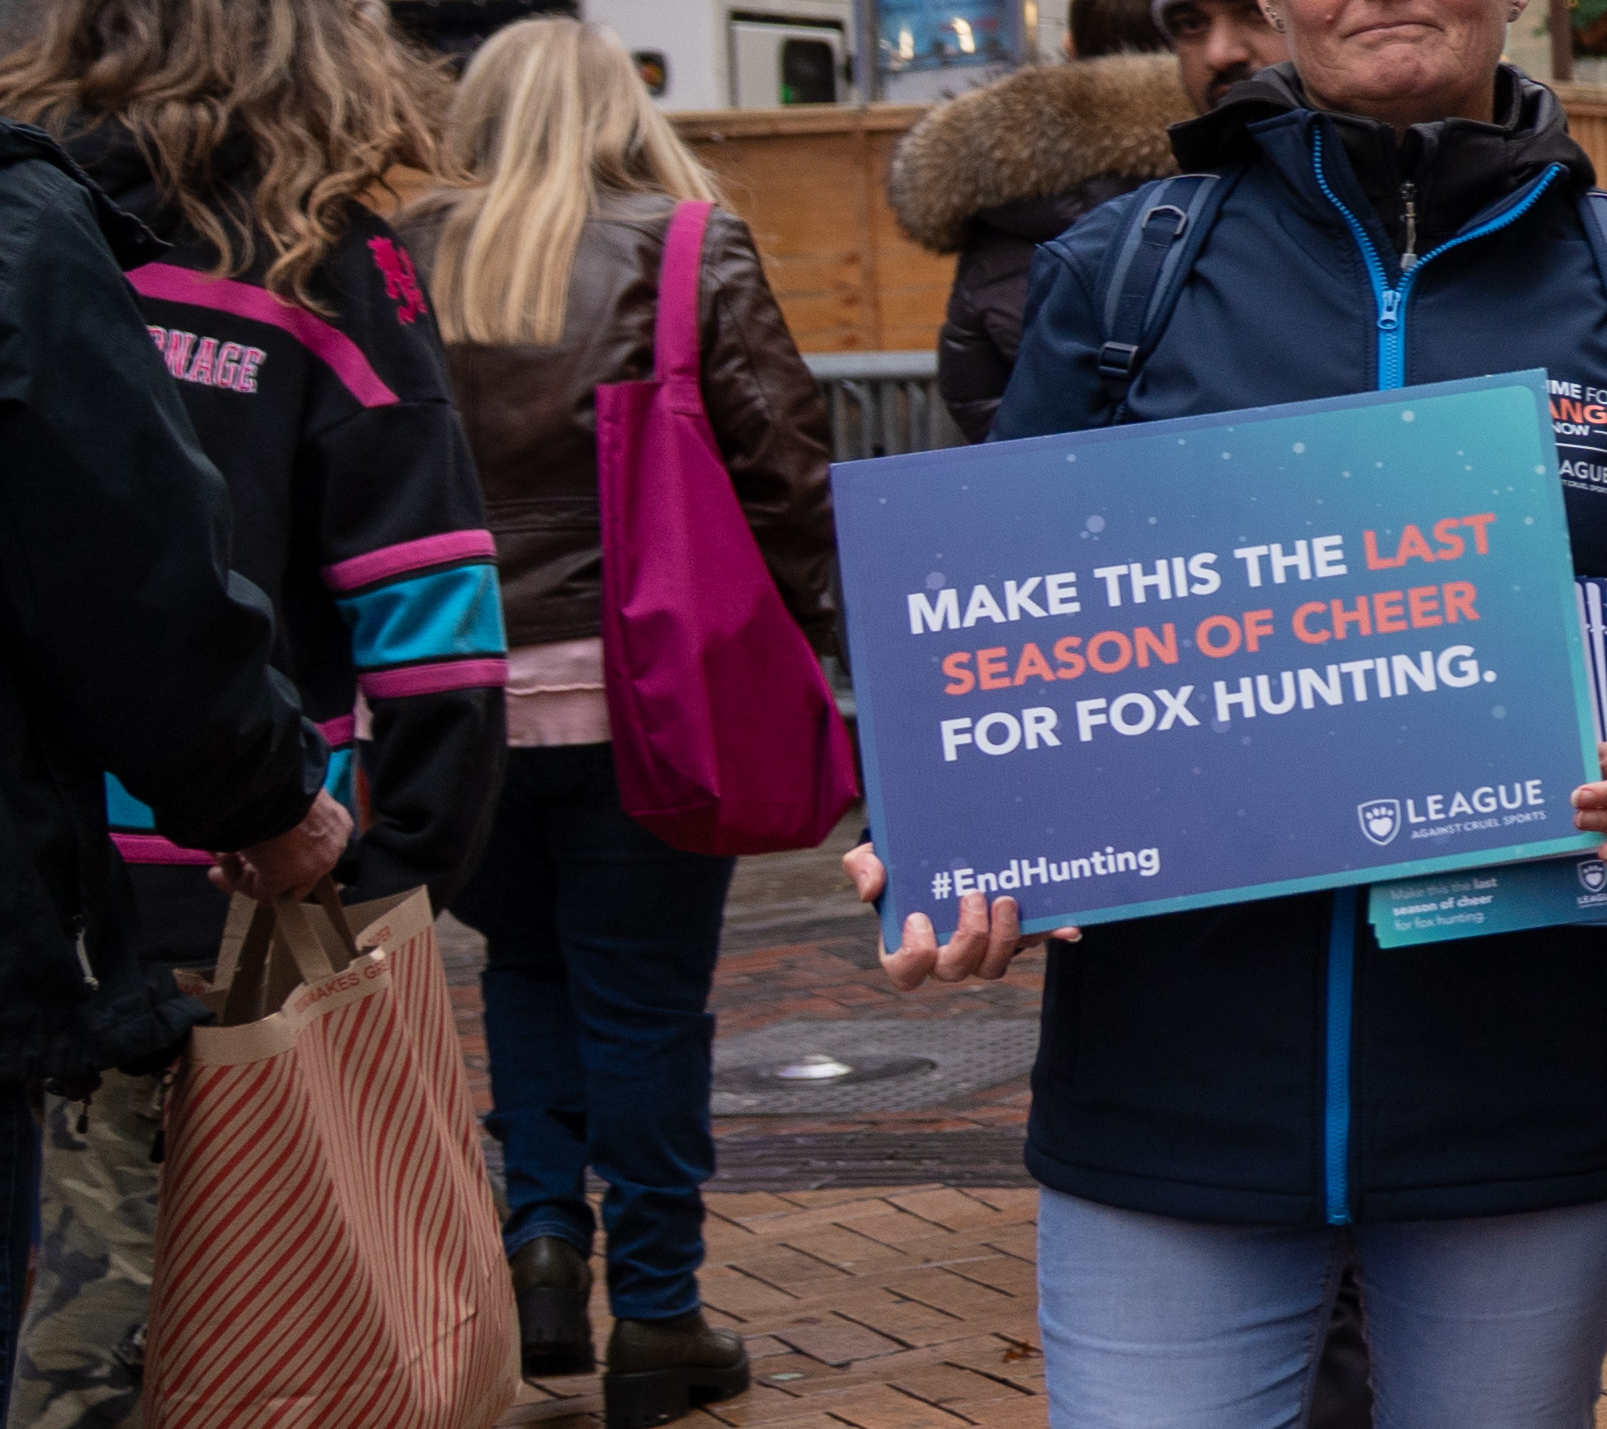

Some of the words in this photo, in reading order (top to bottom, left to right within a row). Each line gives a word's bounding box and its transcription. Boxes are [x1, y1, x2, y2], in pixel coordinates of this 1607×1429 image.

[1545, 378, 1583, 400] IME
[907, 570, 1082, 637] MAKE
[1094, 549, 1222, 608] THIS
[1236, 534, 1348, 588] THE
[1363, 512, 1497, 572] LAST
[941, 623, 1180, 698] SEASON
[1197, 608, 1275, 662] OF
[1291, 579, 1480, 648] CHEER
[940, 704, 1062, 763] FOR
[1077, 684, 1201, 745] FOX
[1214, 642, 1498, 723] HUNTING.
[1405, 778, 1546, 824] LEAGUE
[1411, 822, 1463, 840] AGAINST
[1463, 817, 1501, 833] CRUEL
[1503, 810, 1548, 827] SPORTS
[931, 843, 1161, 903] #EndHunting
[1473, 878, 1498, 890] last
[1392, 902, 1438, 916] season
[1439, 897, 1456, 910] of
[1457, 894, 1495, 908] cheer
